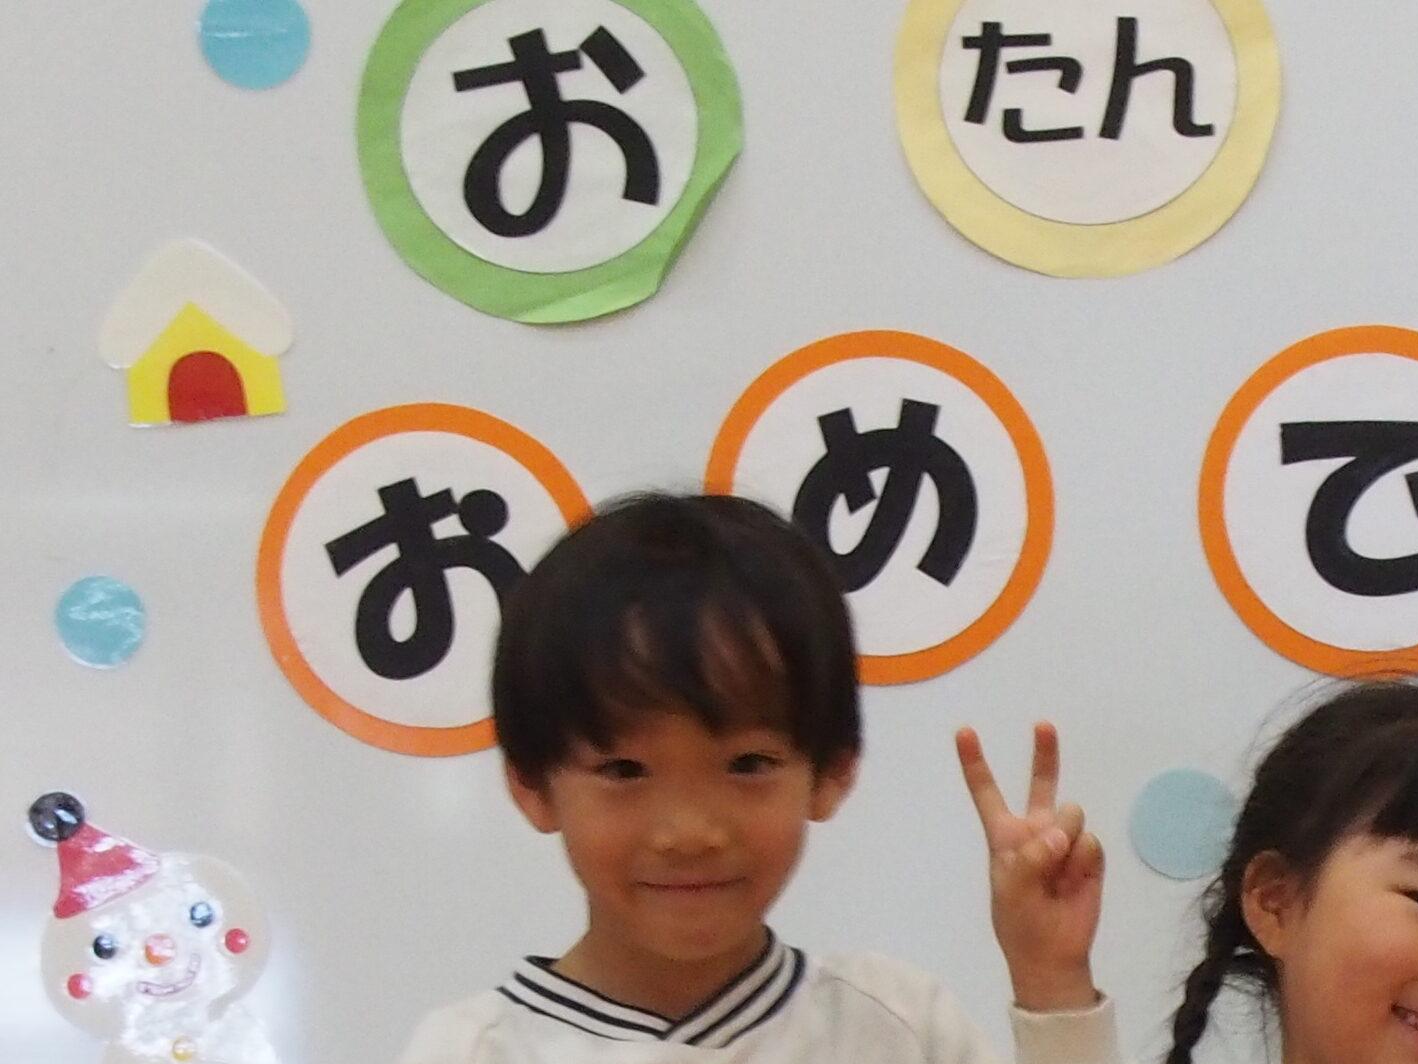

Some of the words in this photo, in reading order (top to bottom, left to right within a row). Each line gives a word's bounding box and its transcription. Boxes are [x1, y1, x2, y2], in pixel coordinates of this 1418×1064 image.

[452, 25, 660, 238] お
[962, 16, 1214, 144] たん
[325, 477, 528, 681] お
[792, 398, 978, 594] め
